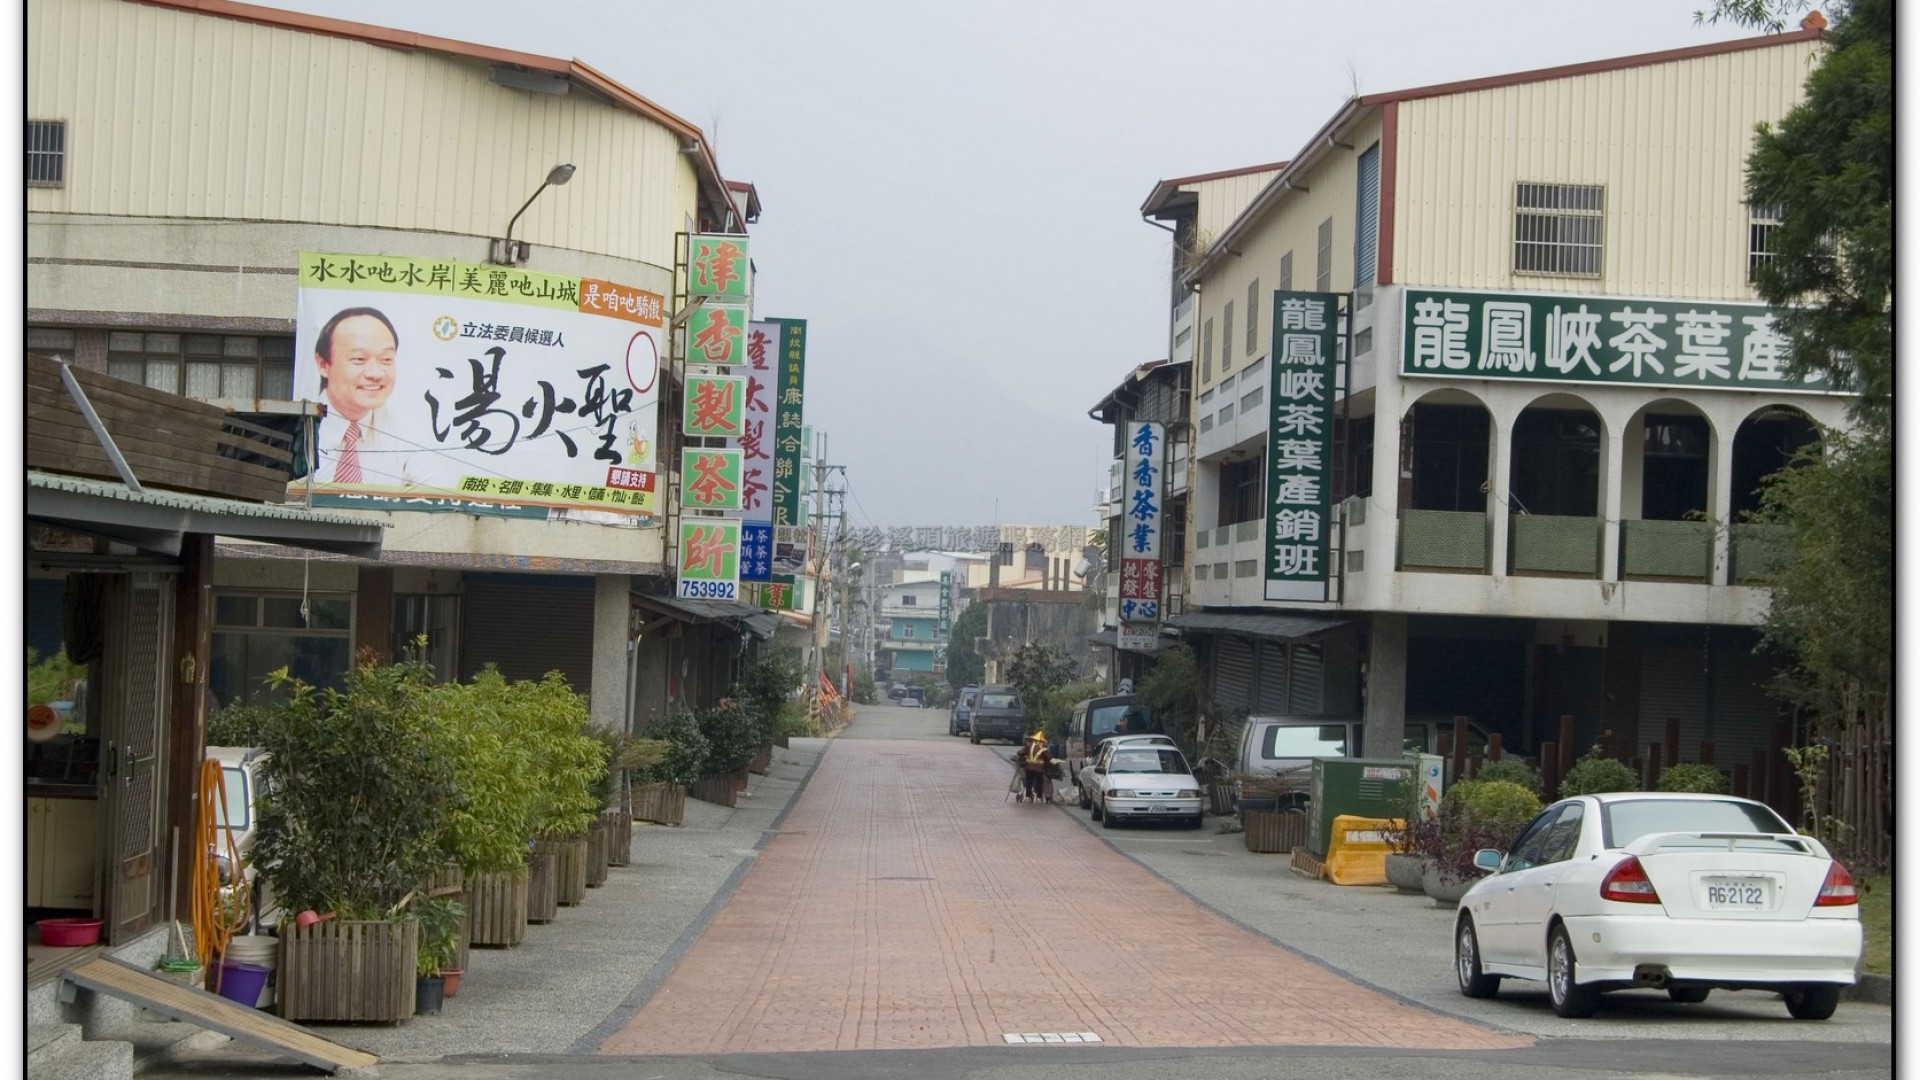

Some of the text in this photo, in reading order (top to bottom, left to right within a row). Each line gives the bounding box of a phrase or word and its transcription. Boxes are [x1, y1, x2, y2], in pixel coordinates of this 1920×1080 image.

[460, 321, 565, 348] 立法委員候選人
[1413, 297, 1856, 384] 龍鳳峽茶葉產
[424, 346, 634, 465] 湯火聖
[683, 240, 745, 577] 津香製茶所
[1274, 298, 1326, 576] 龍鳳峽茶葉產銷班
[1128, 423, 1159, 553] 香香茶業
[682, 580, 735, 599] 753992
[1122, 561, 1159, 599] 批發 零售
[1122, 599, 1157, 619] 中心
